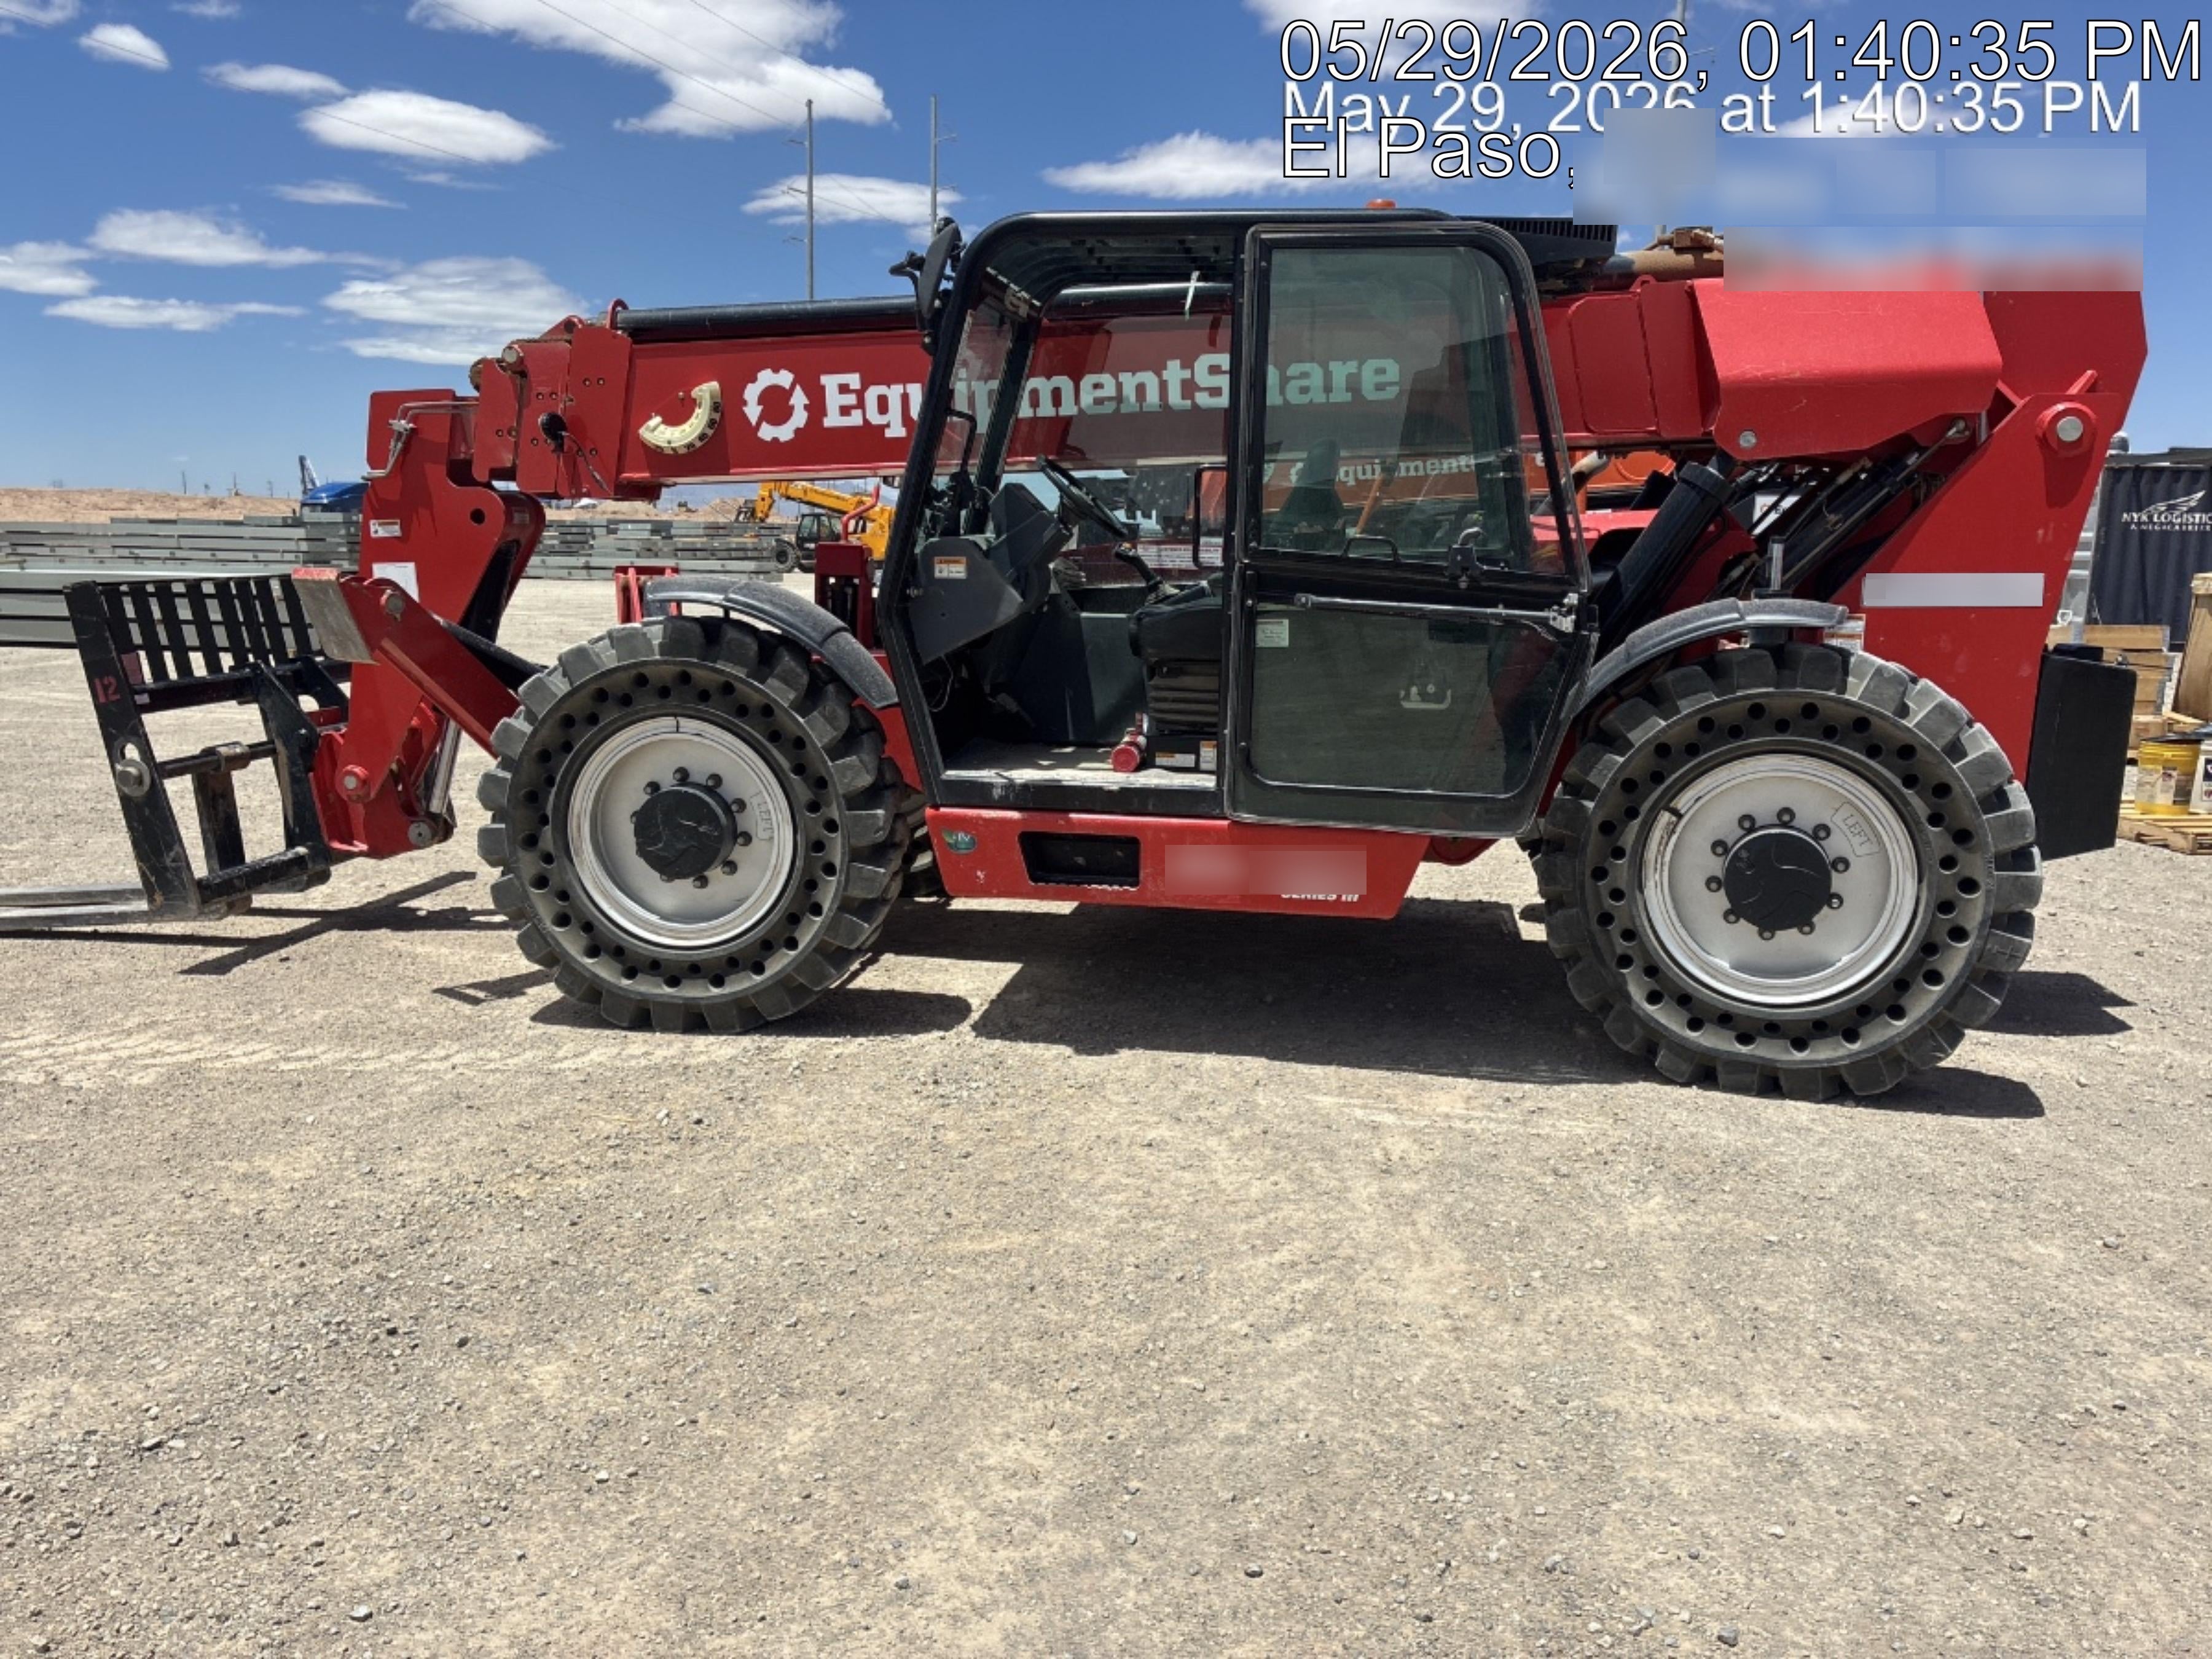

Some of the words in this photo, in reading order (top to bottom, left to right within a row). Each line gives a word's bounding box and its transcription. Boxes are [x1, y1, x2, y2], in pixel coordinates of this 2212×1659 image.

[2121, 512, 2148, 522] NYK
[93, 676, 121, 704] 12
[1843, 814, 1874, 847] LEFT
